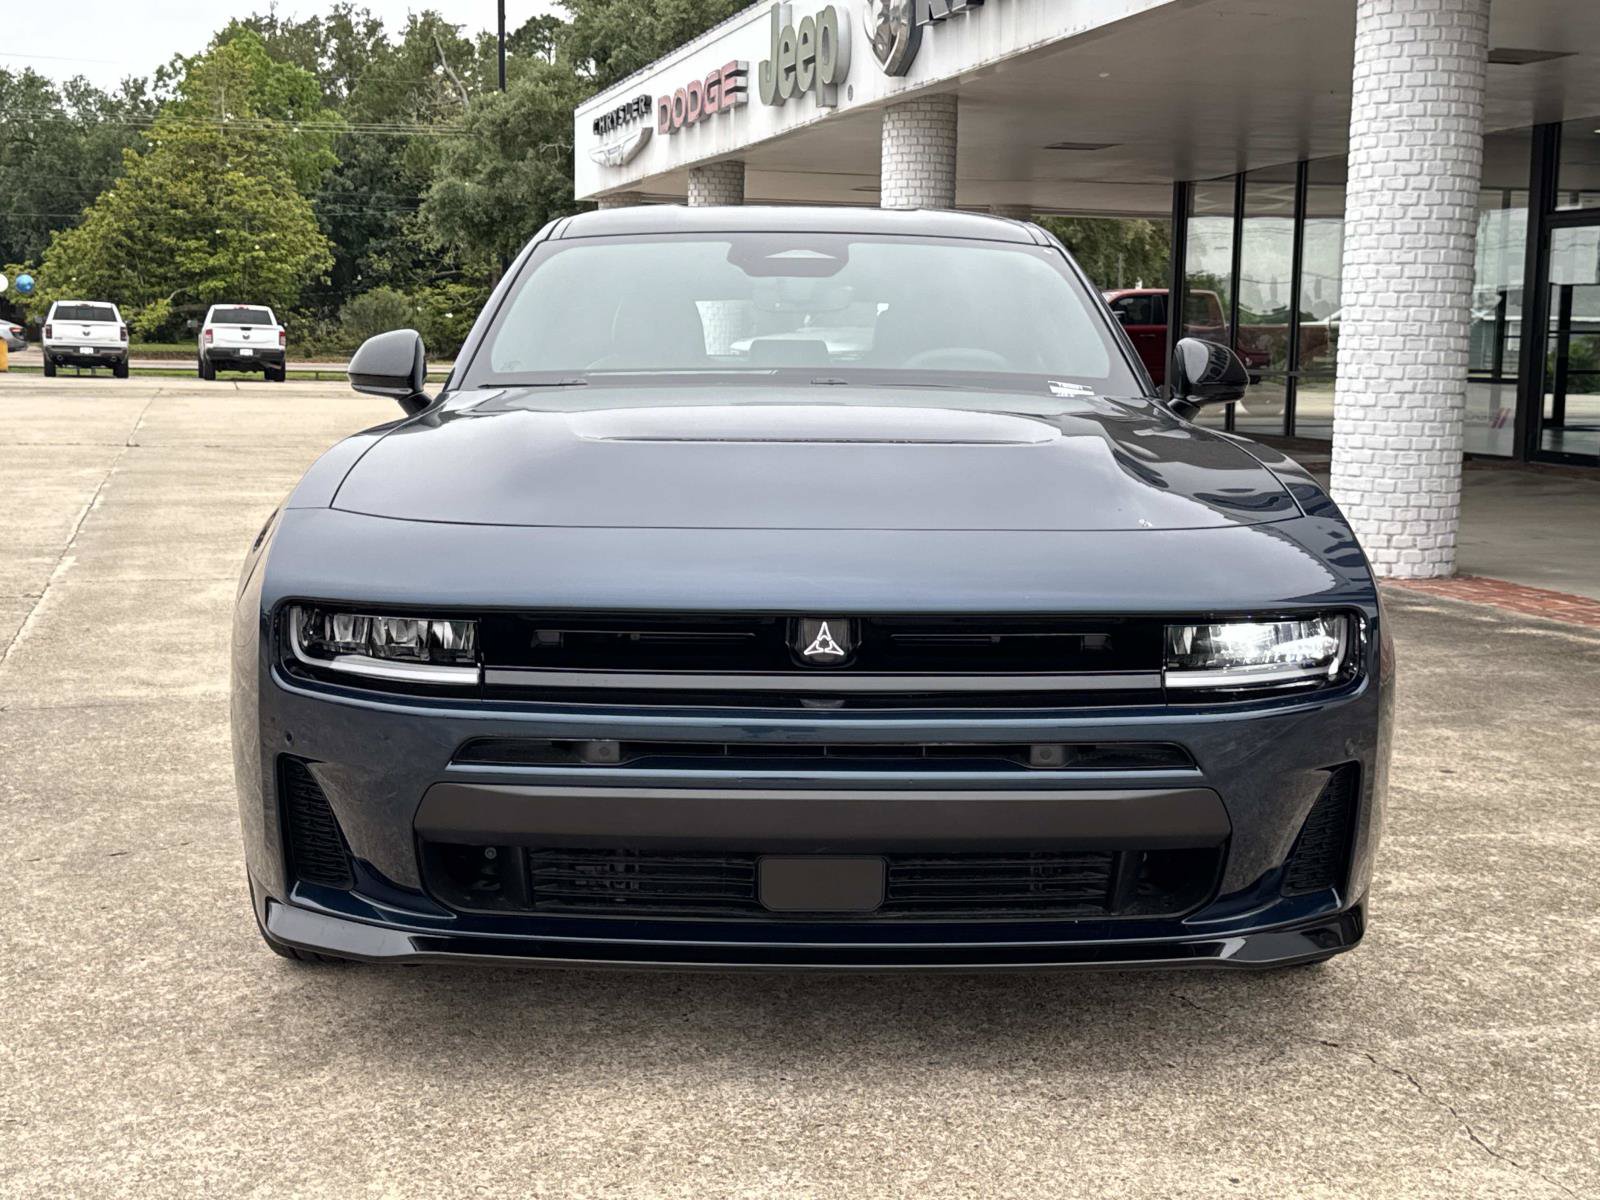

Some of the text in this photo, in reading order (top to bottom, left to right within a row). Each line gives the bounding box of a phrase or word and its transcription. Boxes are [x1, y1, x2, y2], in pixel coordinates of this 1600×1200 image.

[758, 2, 848, 107] Jeep
[593, 94, 652, 135] CHRYSLER
[658, 60, 746, 135] DODGE
